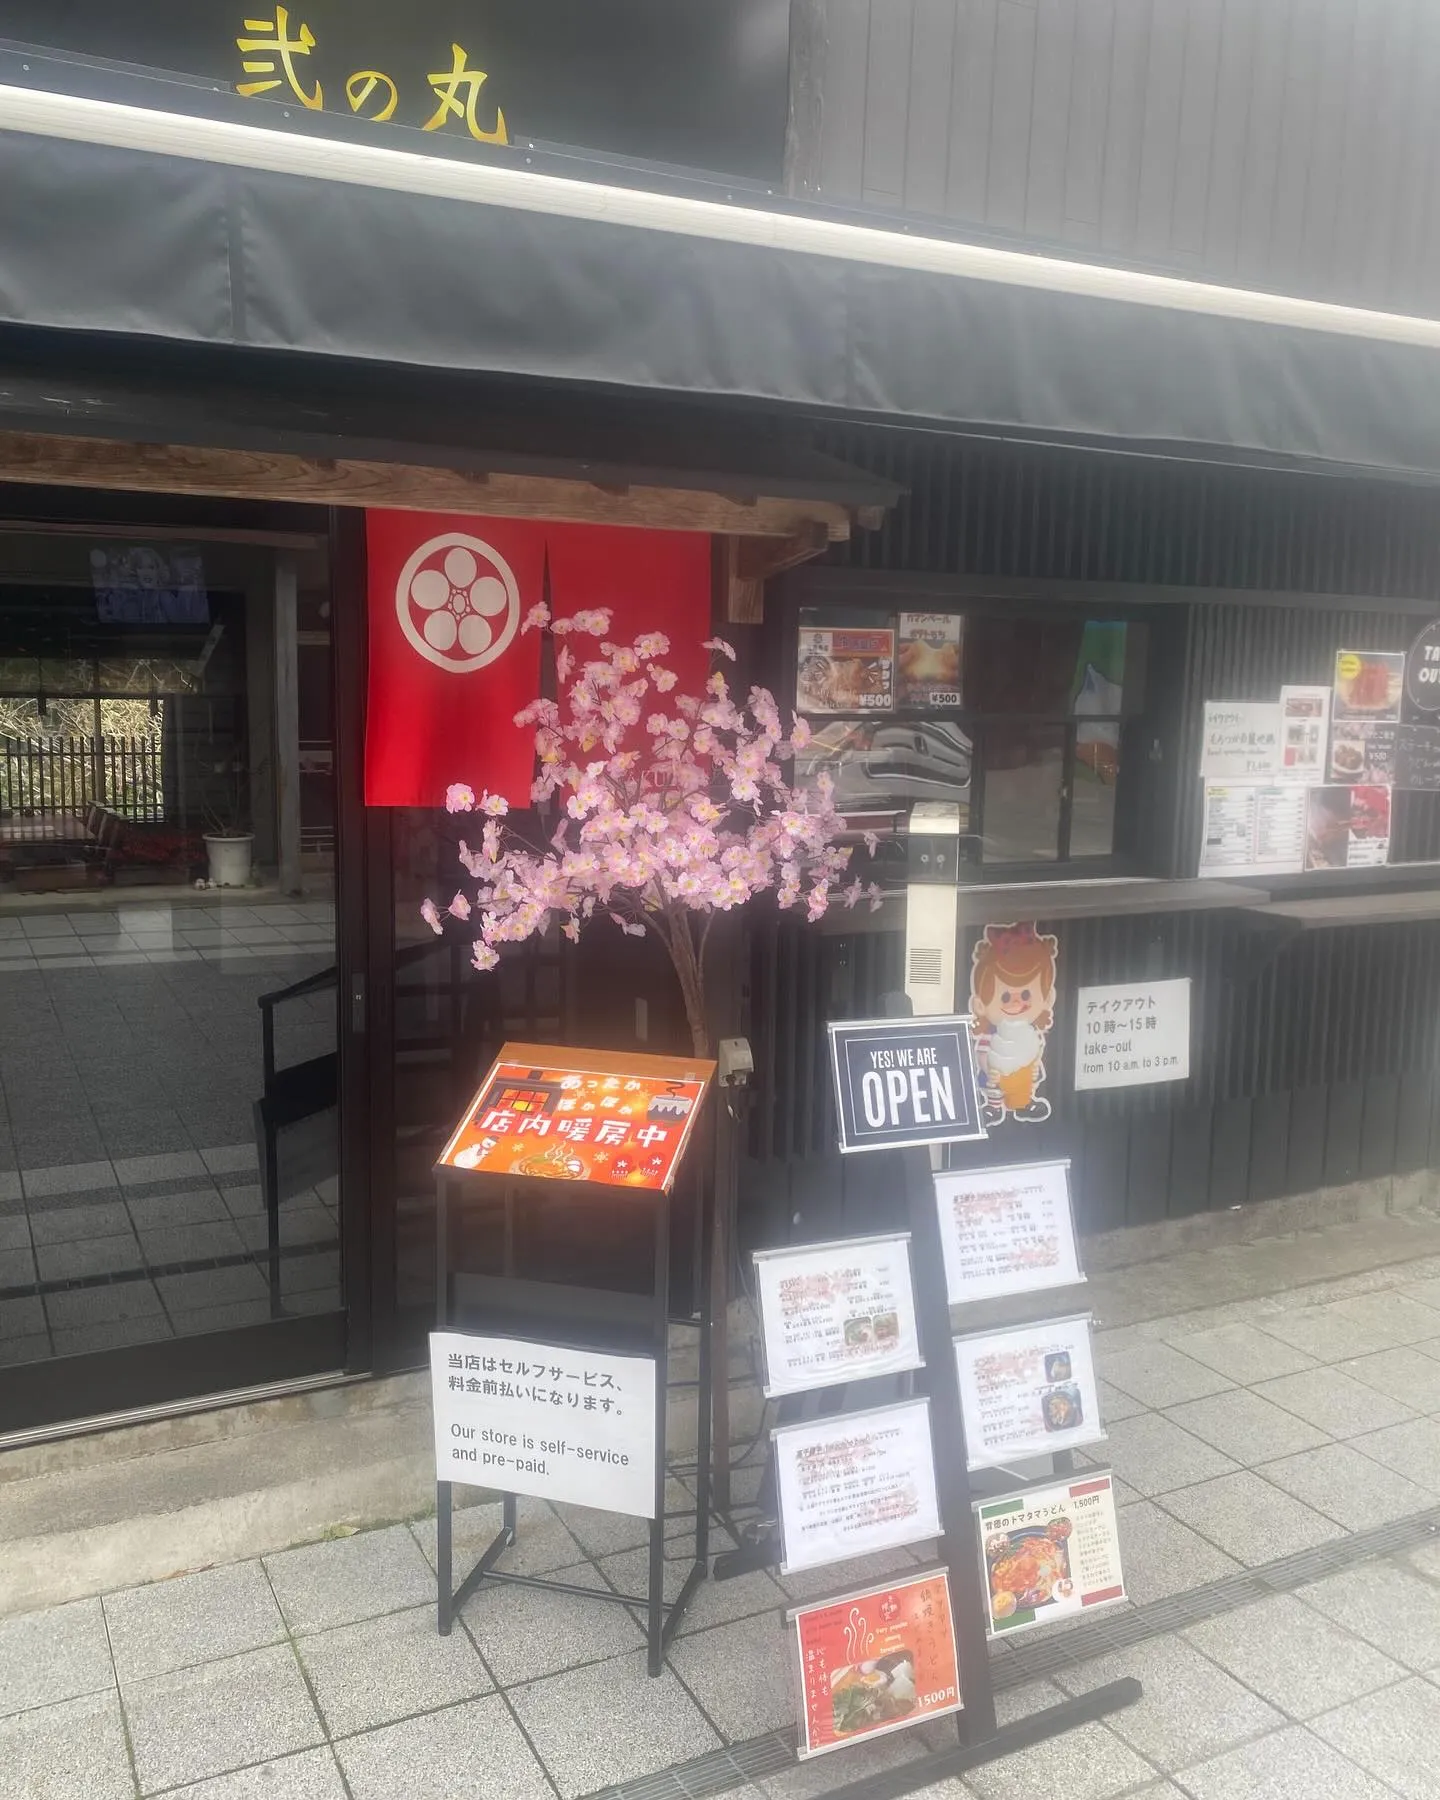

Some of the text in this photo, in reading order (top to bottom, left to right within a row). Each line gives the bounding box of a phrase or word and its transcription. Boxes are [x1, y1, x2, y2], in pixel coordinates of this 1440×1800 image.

[236, 5, 508, 145] 弐の丸
[1087, 995, 1156, 1014] テイクアウト
[870, 1047, 938, 1069] YES! WE ARE
[1084, 1040, 1132, 1055] take-out
[1083, 1062, 1104, 1074] from
[1108, 1060, 1120, 1072] 10
[1143, 1057, 1151, 1068] to
[1154, 1056, 1160, 1067] 3
[560, 1075, 641, 1091] あったか
[862, 1066, 956, 1128] OPEN
[480, 1109, 668, 1148] 店内暖房中
[448, 1353, 622, 1391] 当店はセルフサービス、
[448, 1376, 623, 1415] 料金前払いになります。
[451, 1424, 629, 1465] Our store is self-service
[452, 1447, 550, 1475] and pre-paid.
[1073, 1495, 1100, 1509] 1,500円
[918, 1686, 955, 1708] 1500円
